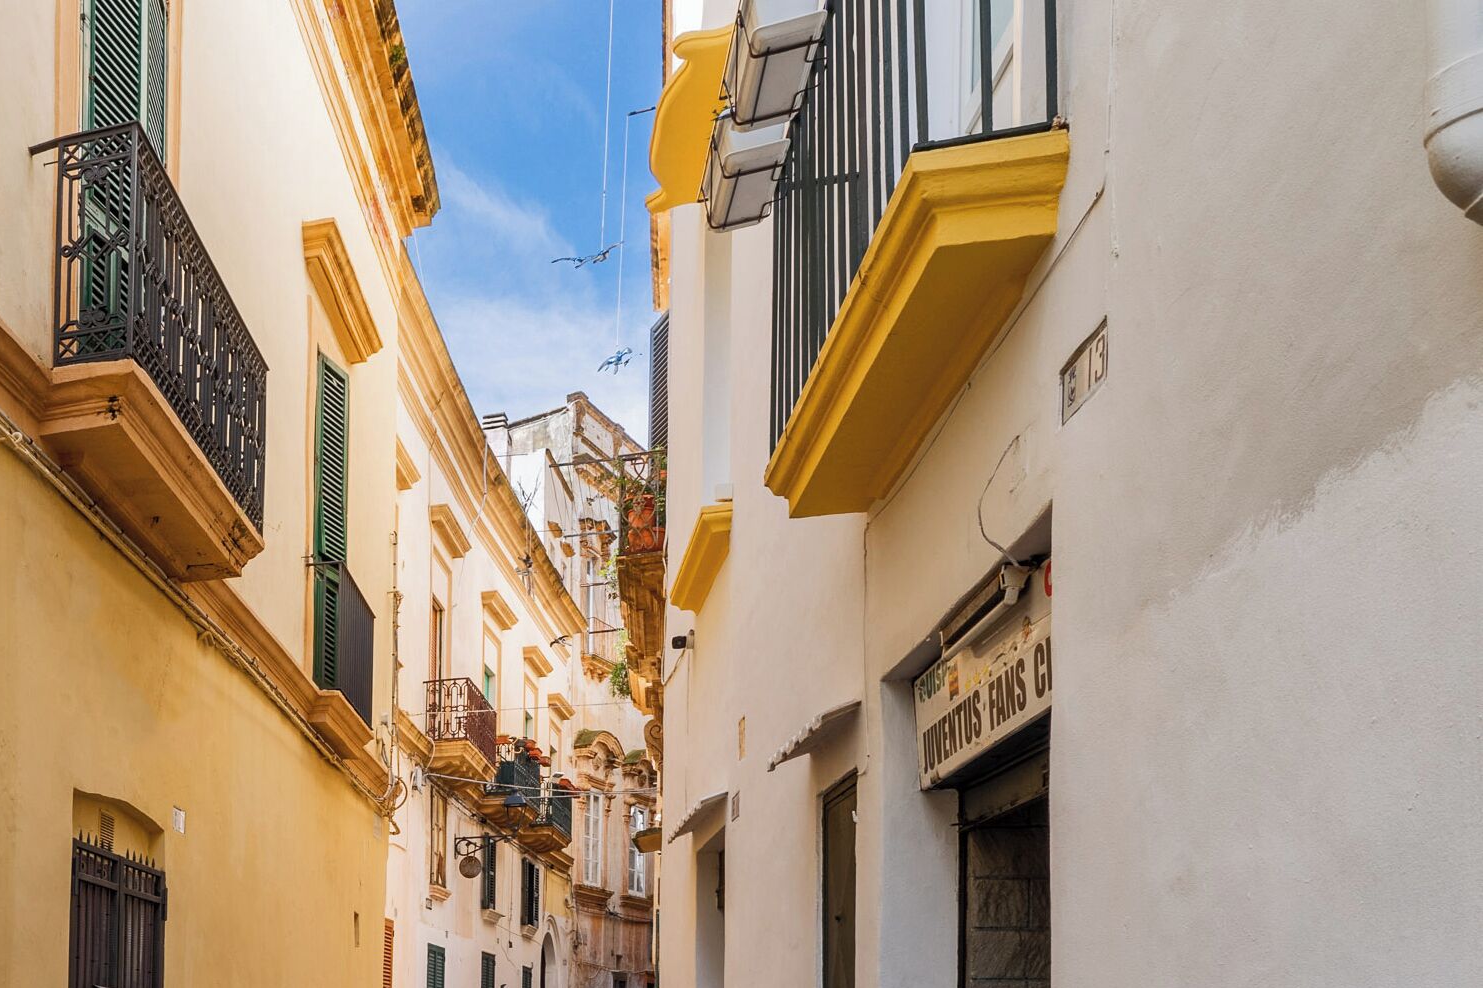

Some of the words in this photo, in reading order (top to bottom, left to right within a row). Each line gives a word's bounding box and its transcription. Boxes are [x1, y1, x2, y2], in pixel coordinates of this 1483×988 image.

[1088, 333, 1106, 391] 13
[923, 689, 982, 774] JUVENTUS
[988, 657, 1027, 731] FANS
